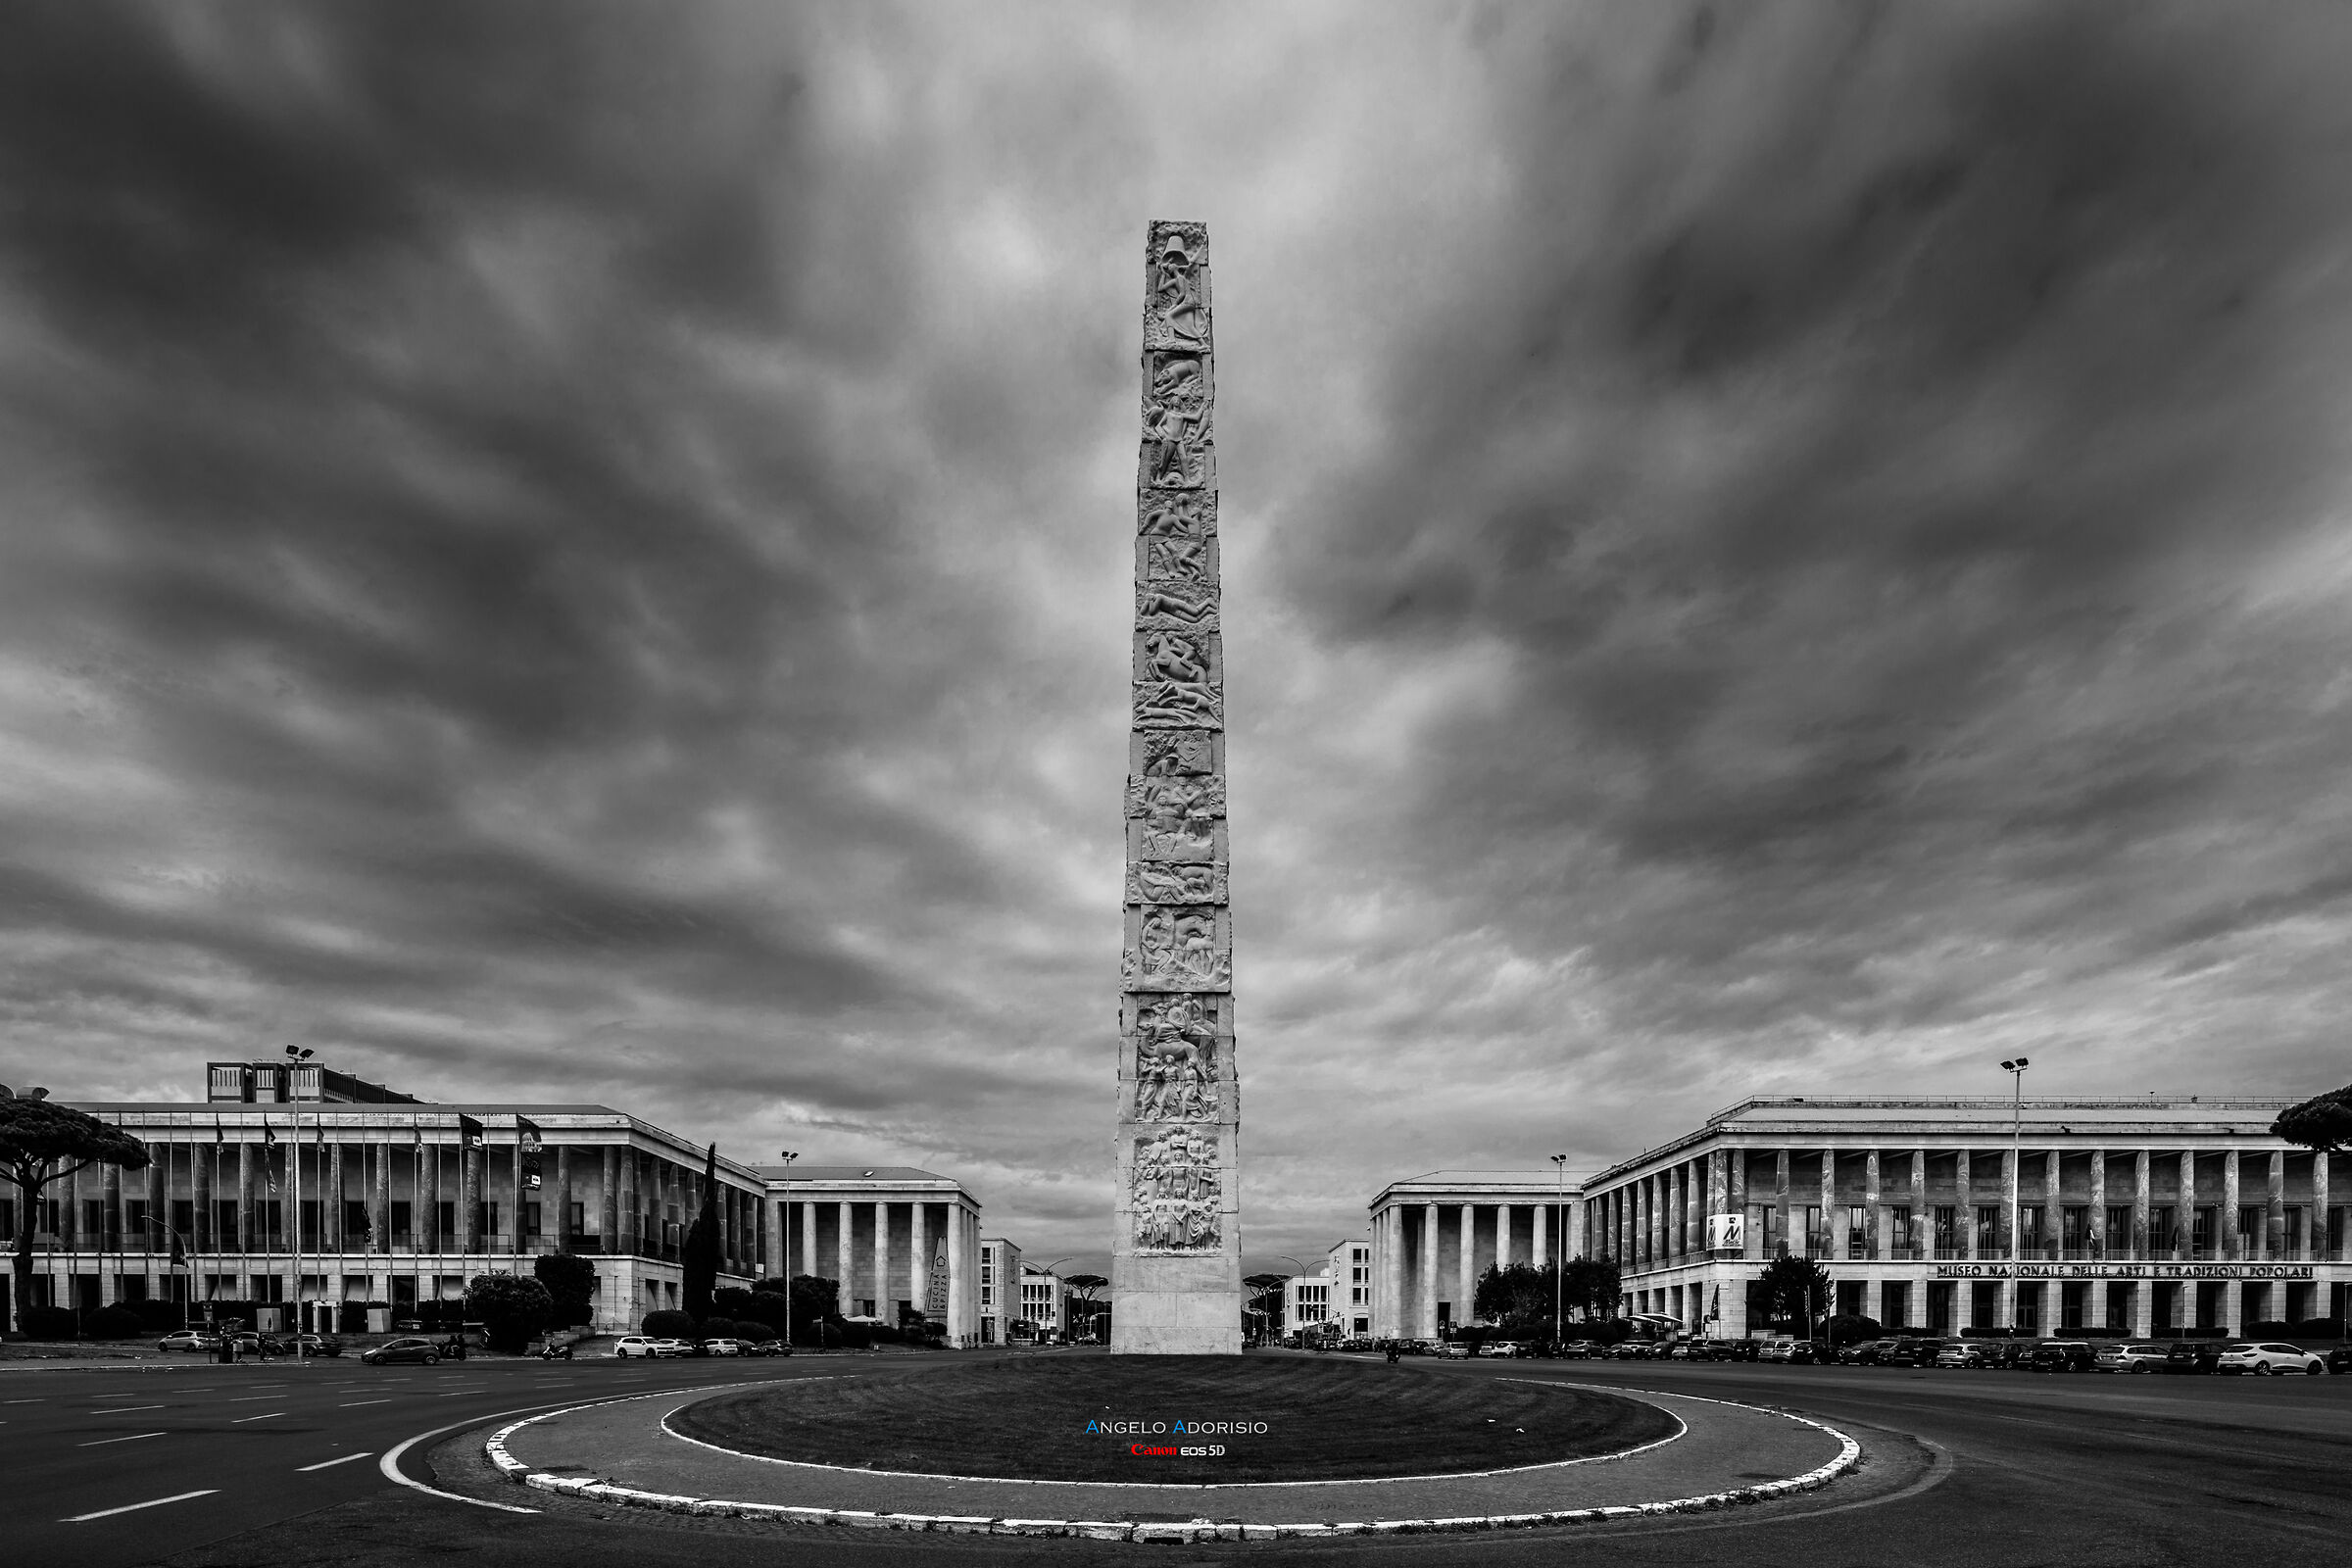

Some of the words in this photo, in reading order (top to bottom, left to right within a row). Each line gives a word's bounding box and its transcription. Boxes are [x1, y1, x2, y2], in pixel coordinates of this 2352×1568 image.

[1936, 1265, 1982, 1277] MUSEO
[2072, 1265, 2107, 1277] DELLE
[2116, 1265, 2146, 1277] ARTI
[2153, 1266, 2161, 1277] E
[2166, 1266, 2242, 1278] TRADIZIONI
[2249, 1266, 2313, 1278] POPOLARI
